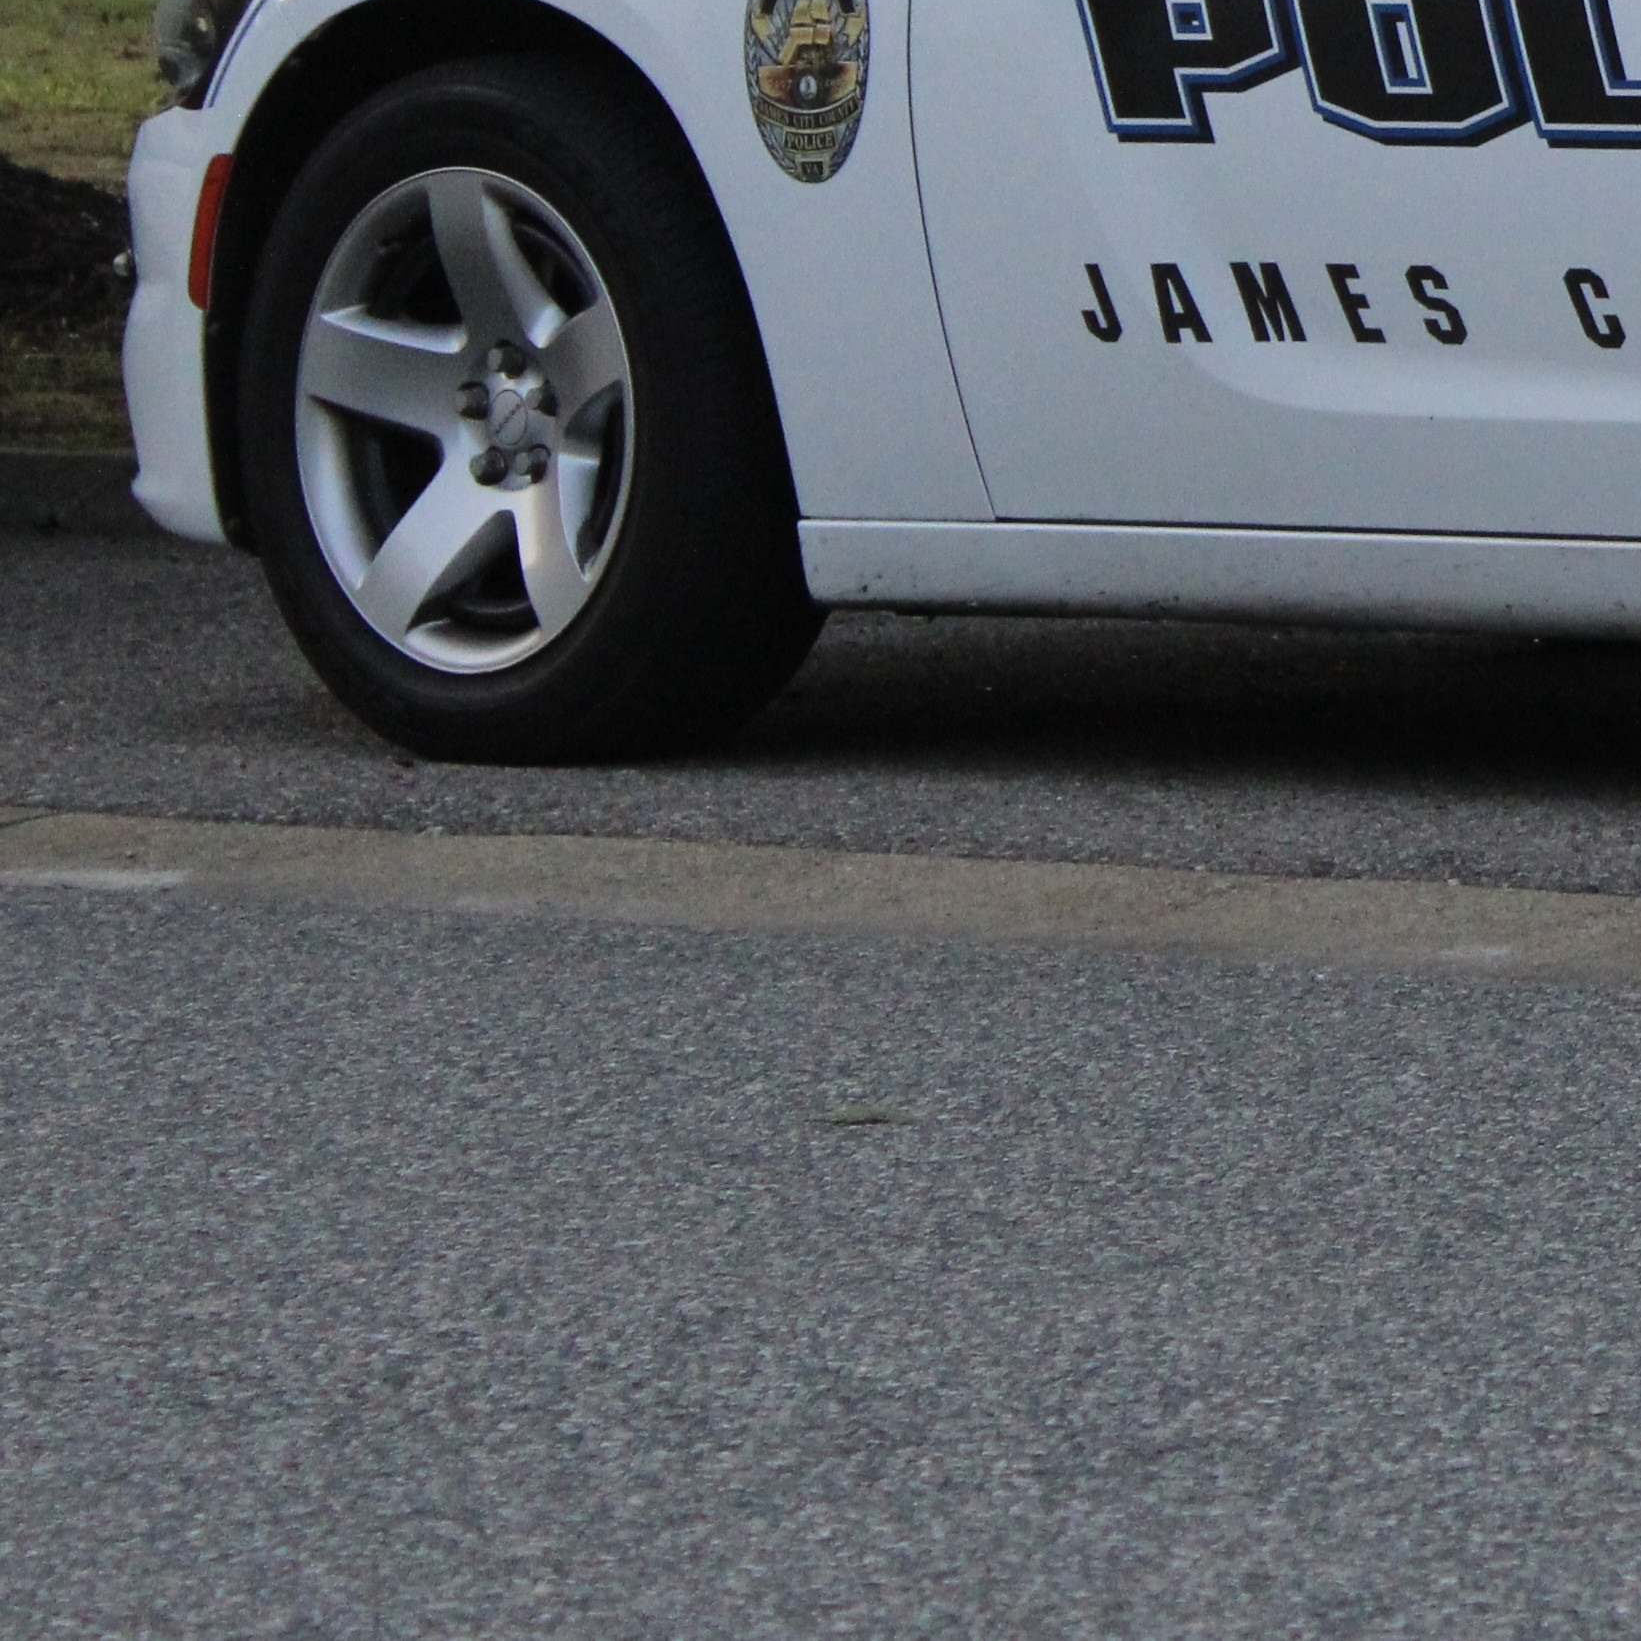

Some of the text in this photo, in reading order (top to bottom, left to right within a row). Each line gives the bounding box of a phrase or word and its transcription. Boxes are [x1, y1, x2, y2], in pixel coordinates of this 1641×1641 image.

[793, 114, 817, 128] CITY
[786, 132, 834, 150] POLICE
[805, 162, 820, 174] VA
[1081, 262, 1467, 345] JAMES
